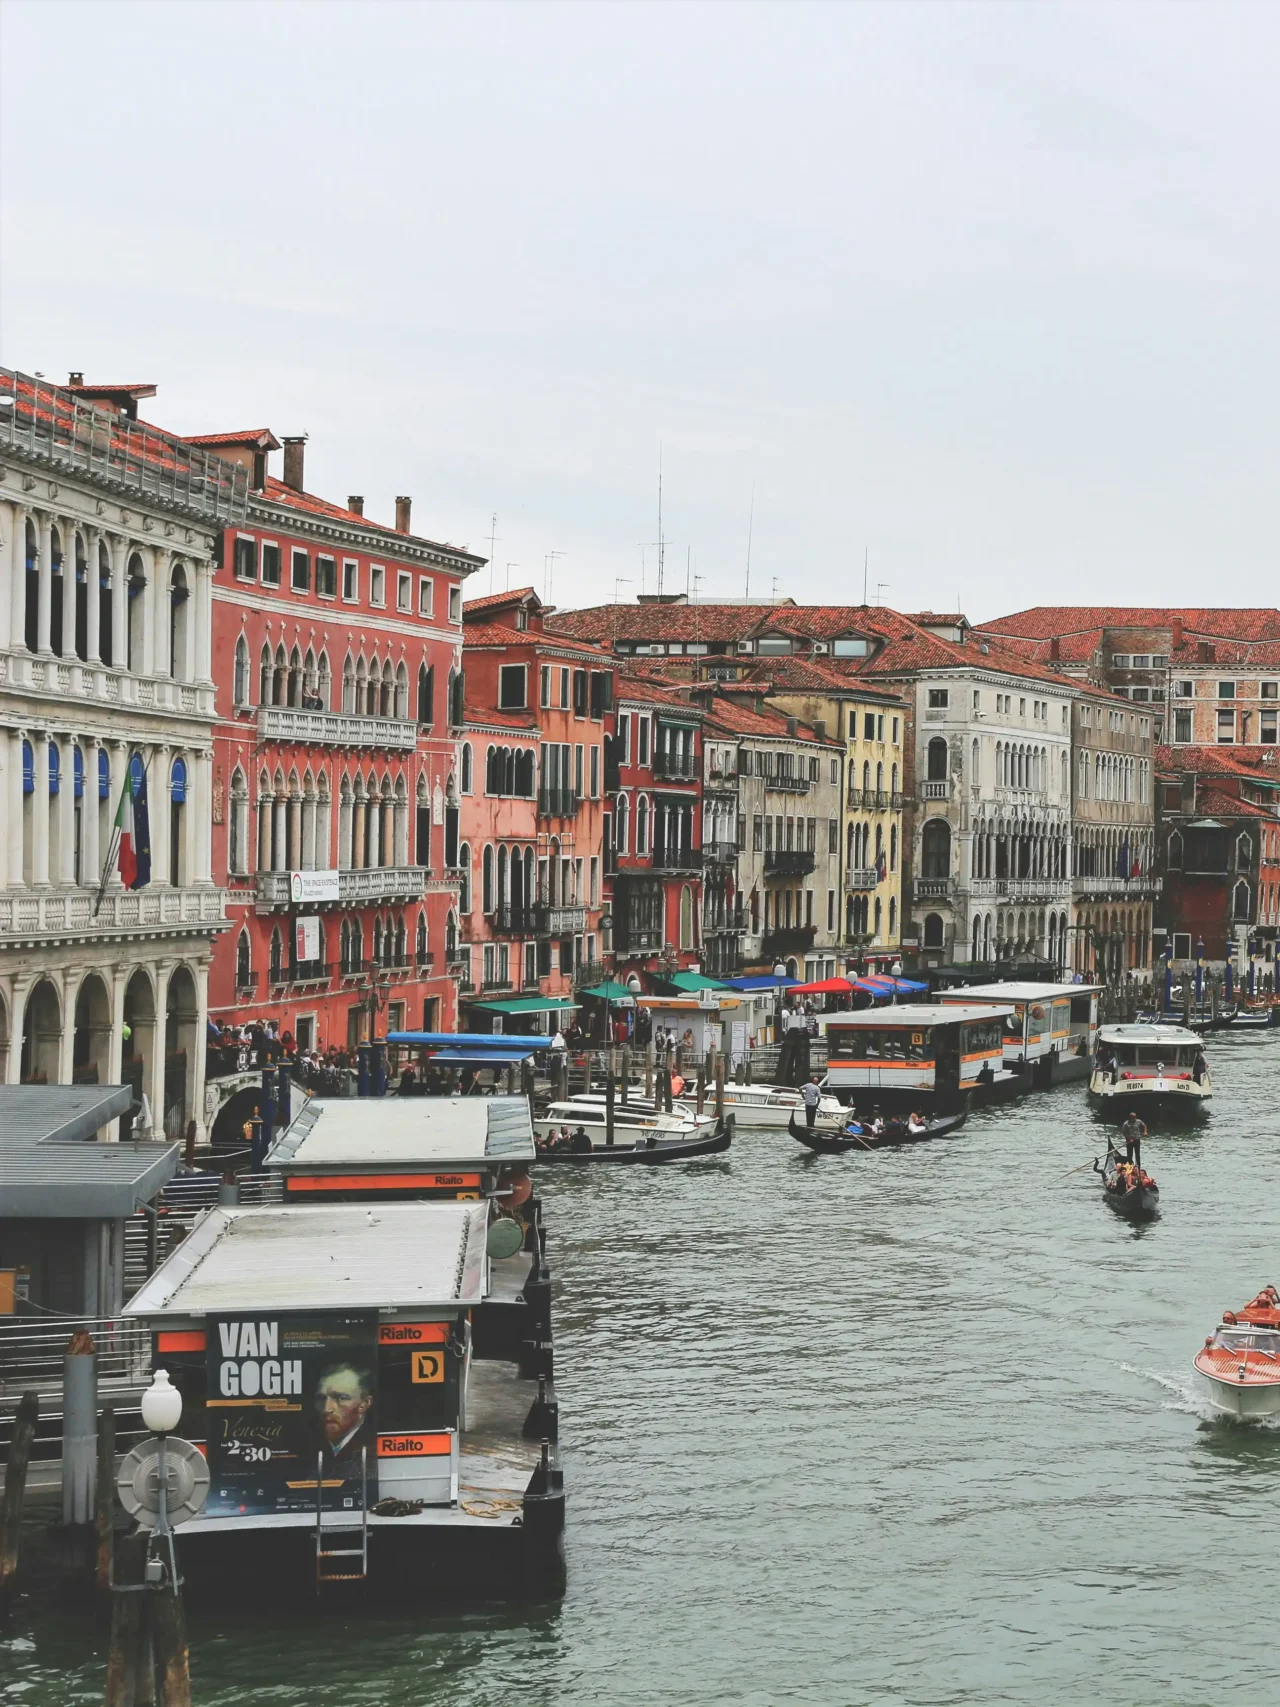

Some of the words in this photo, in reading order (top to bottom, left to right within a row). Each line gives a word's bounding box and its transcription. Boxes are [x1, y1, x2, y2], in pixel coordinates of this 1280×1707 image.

[435, 1175, 464, 1185] Rialto
[218, 1321, 279, 1358] VAN
[380, 1327, 422, 1341] Rialto
[219, 1360, 303, 1397] GOGH
[418, 1355, 439, 1379] D
[222, 1416, 283, 1441] Venezia
[382, 1439, 424, 1452] Rialto
